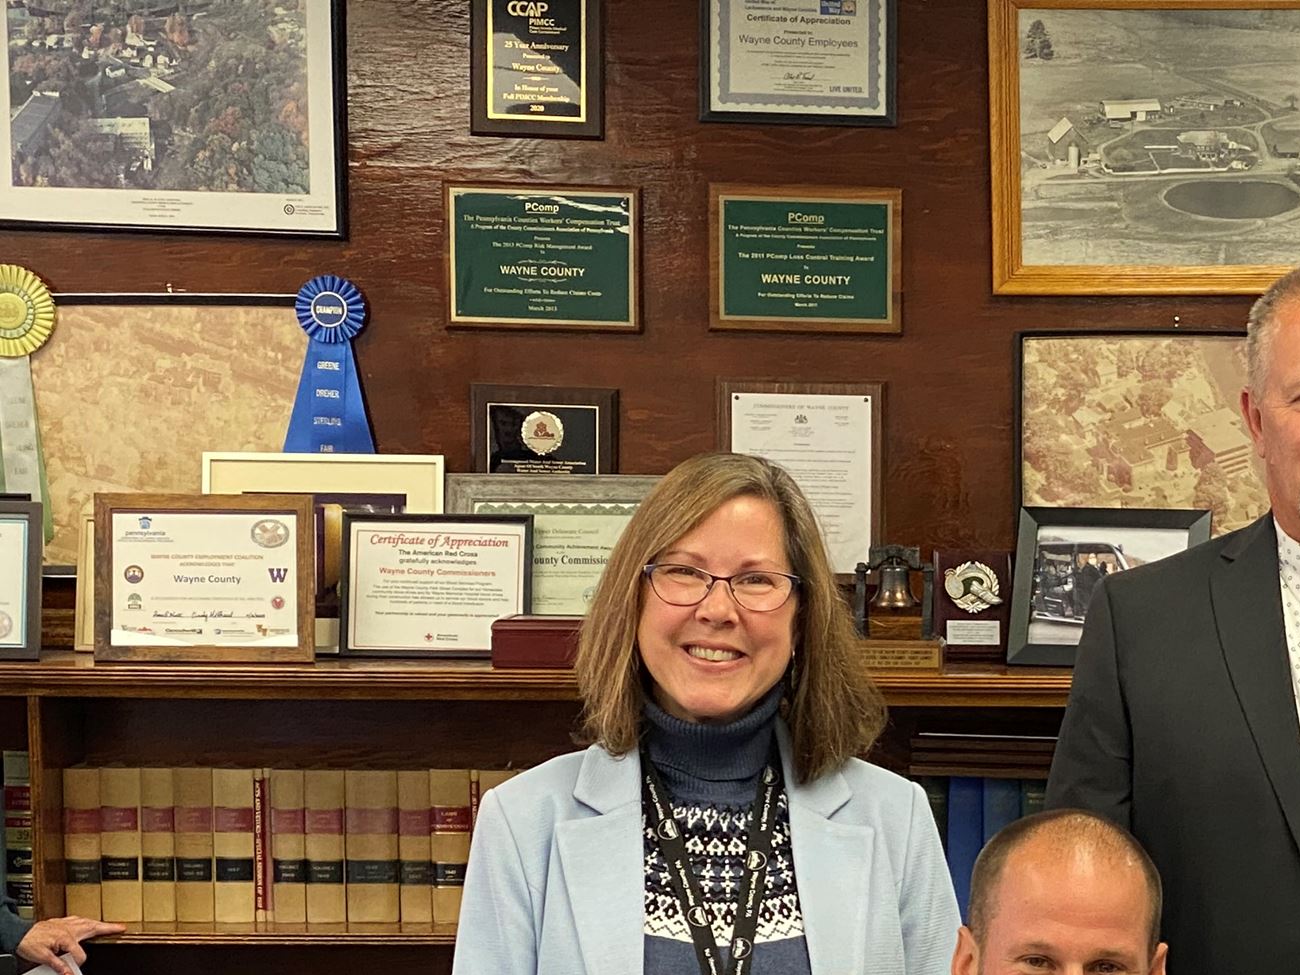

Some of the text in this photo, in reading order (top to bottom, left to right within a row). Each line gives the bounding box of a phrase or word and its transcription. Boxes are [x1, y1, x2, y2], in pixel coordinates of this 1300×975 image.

[507, 1, 549, 17] CCAP
[529, 18, 555, 26] PIMCC
[747, 14, 851, 25] Certificate of Appreciation
[514, 41, 530, 49] Year
[530, 42, 569, 51] Anniversary
[739, 35, 858, 49] Wayne County Employees
[512, 62, 560, 73] Wayne County
[525, 202, 559, 213] PComp
[476, 215, 512, 223] Pennsylvania
[788, 213, 825, 223] PComp
[500, 265, 585, 277] WAYNE COUNTY
[761, 273, 851, 285] WAYNE COUNTY
[370, 534, 509, 550] Certificate of Appreciation
[534, 555, 609, 567] ounty Commissio
[379, 567, 496, 577] Wayne County Commissioners
[174, 575, 241, 585] Wayne County
